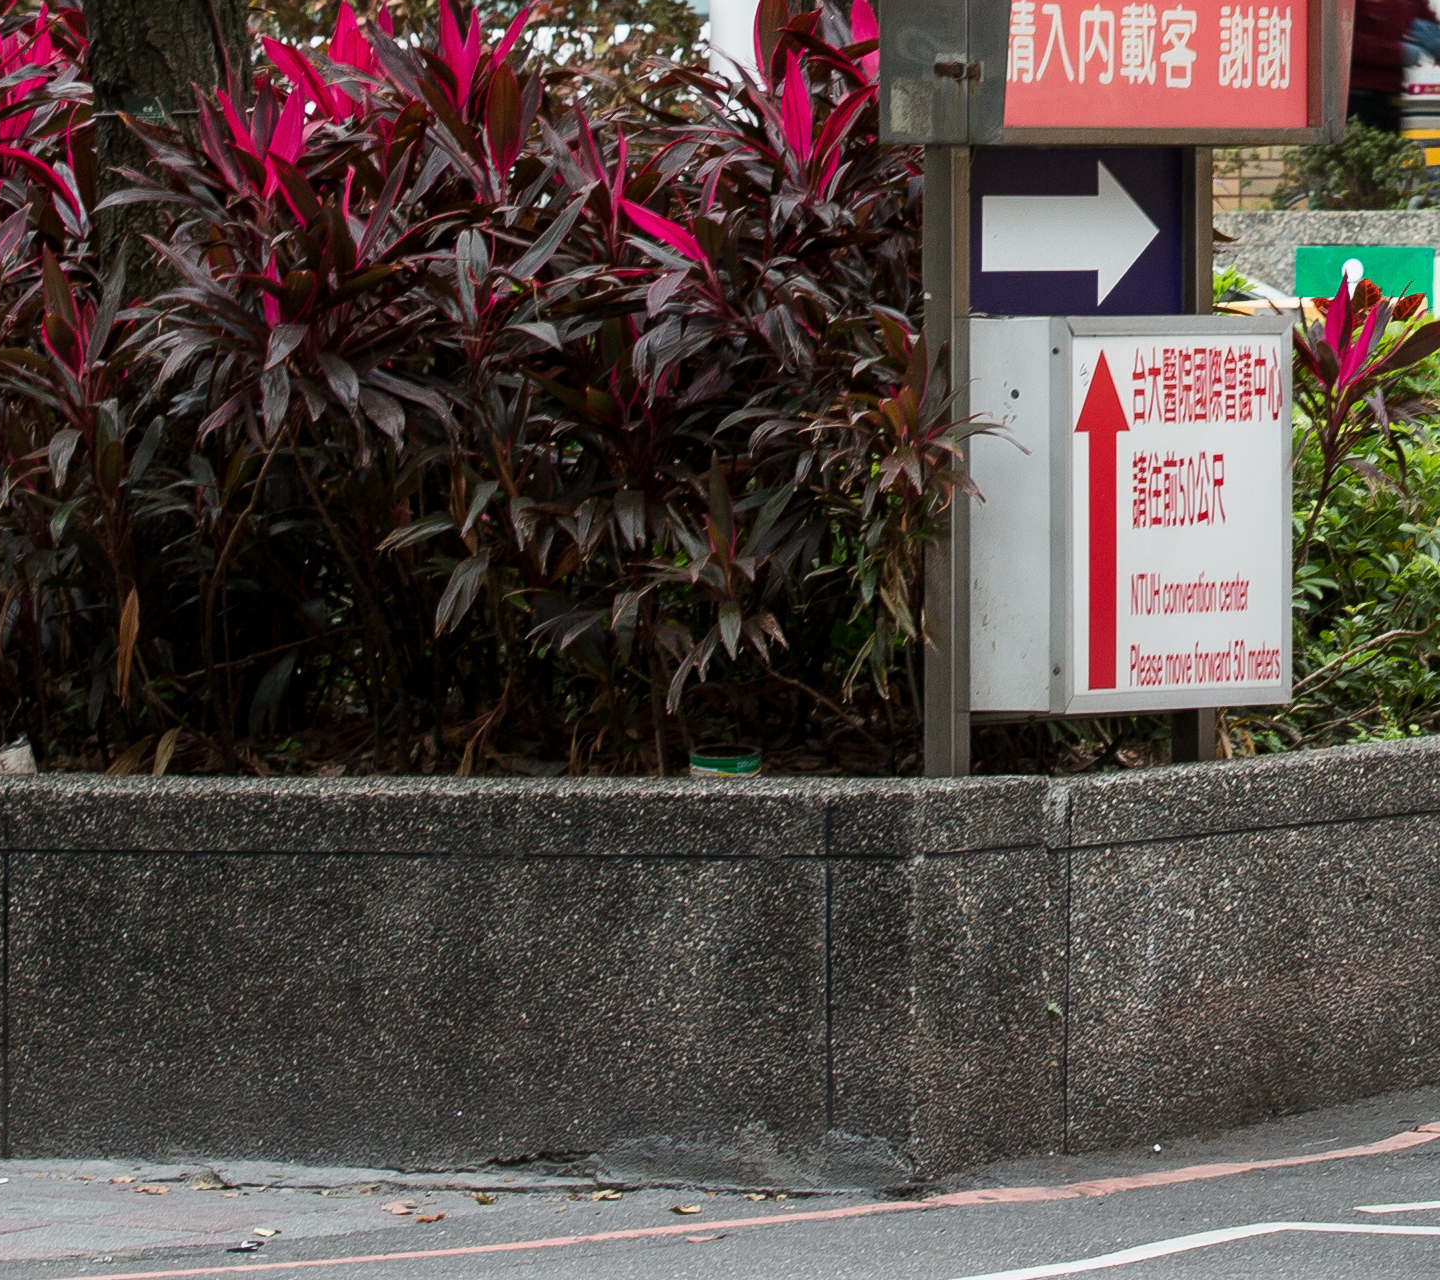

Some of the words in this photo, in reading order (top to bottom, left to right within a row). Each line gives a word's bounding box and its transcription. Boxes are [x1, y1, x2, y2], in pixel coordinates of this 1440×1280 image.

[1218, 3, 1292, 90] 謝謝
[1132, 345, 1283, 425] 台大醫院國際會議中心
[1132, 450, 1226, 529] 請往前50公尺
[1130, 572, 1161, 616] NTUH
[1163, 570, 1216, 615] convention
[1219, 571, 1250, 612] center
[1130, 643, 1163, 687] Please
[1165, 653, 1192, 685] move
[1194, 640, 1232, 684] forward
[1233, 639, 1246, 682] 50
[1248, 640, 1281, 681] meters
